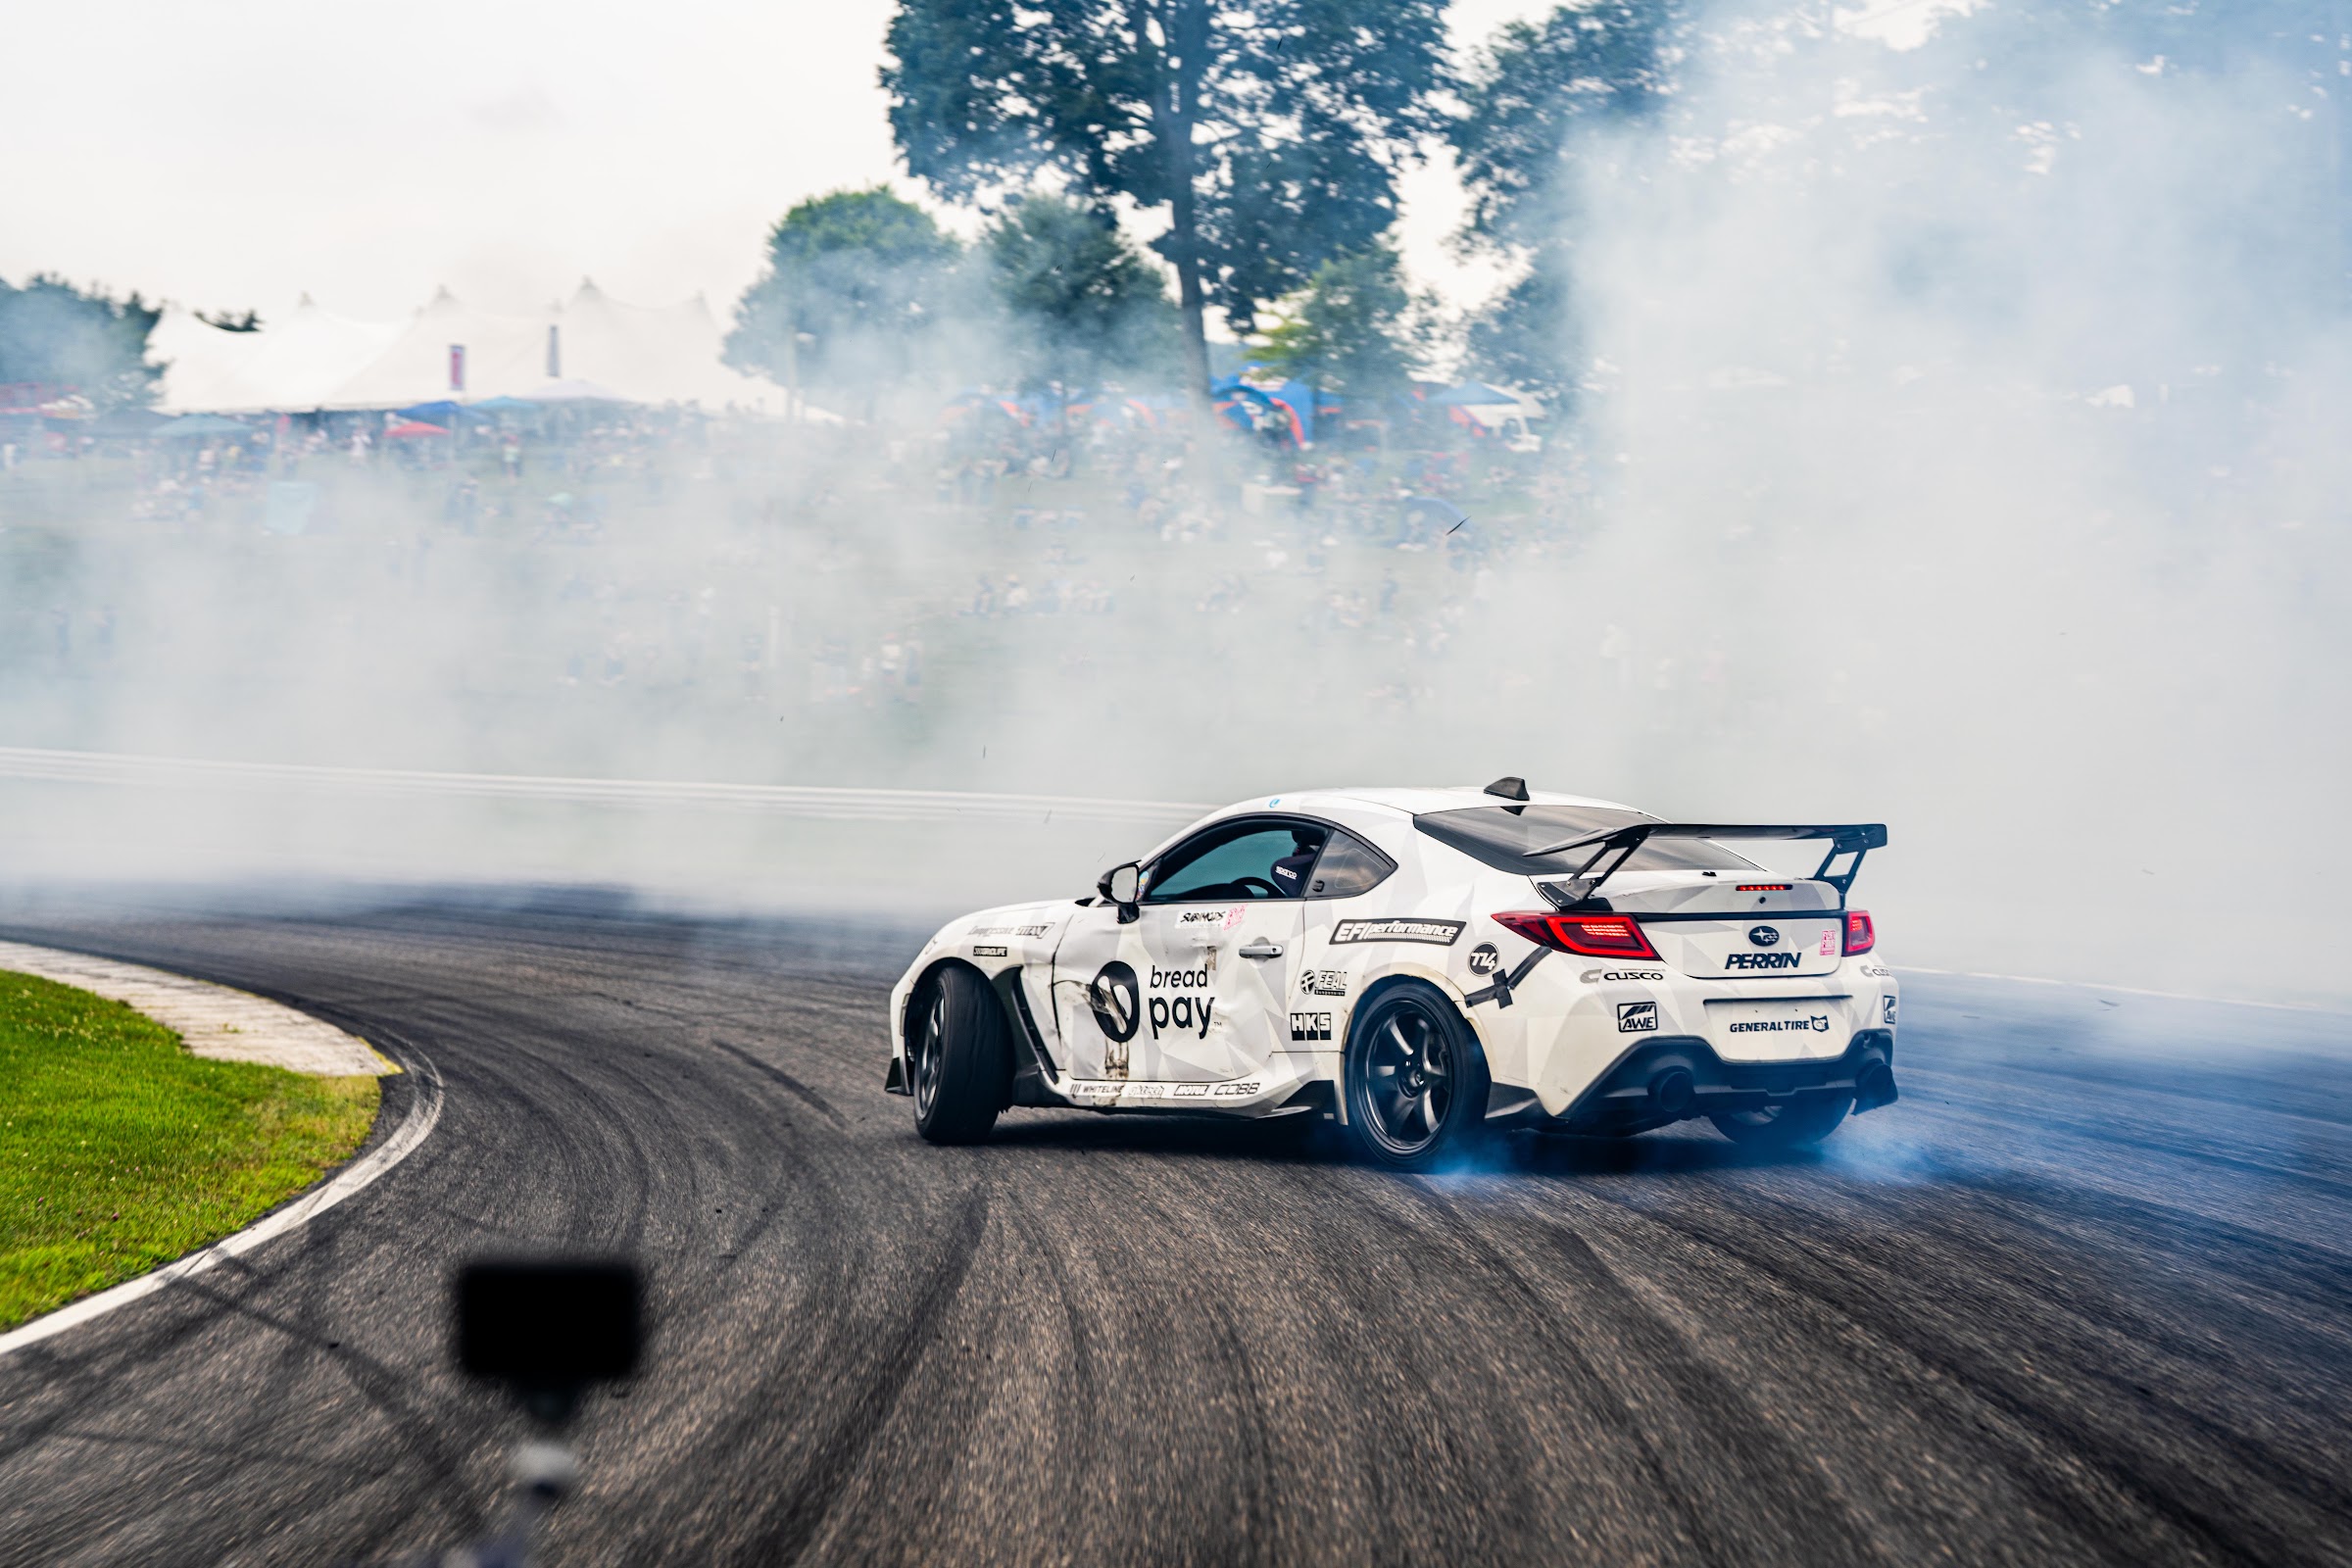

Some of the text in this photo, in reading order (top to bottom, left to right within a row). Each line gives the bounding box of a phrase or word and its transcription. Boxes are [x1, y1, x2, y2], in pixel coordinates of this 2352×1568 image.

[1368, 920, 1458, 937] performance
[1725, 953, 1802, 969] PERRIN
[1150, 963, 1208, 989] bread
[1315, 970, 1347, 990] FEAL
[1149, 996, 1215, 1040] pay
[1291, 1013, 1331, 1032] HKS
[1622, 1017, 1655, 1030] AWE
[1730, 1020, 1809, 1033] GENERAL TIRE
[1175, 1085, 1208, 1096] MOTUL
[1214, 1083, 1260, 1096] COBB
